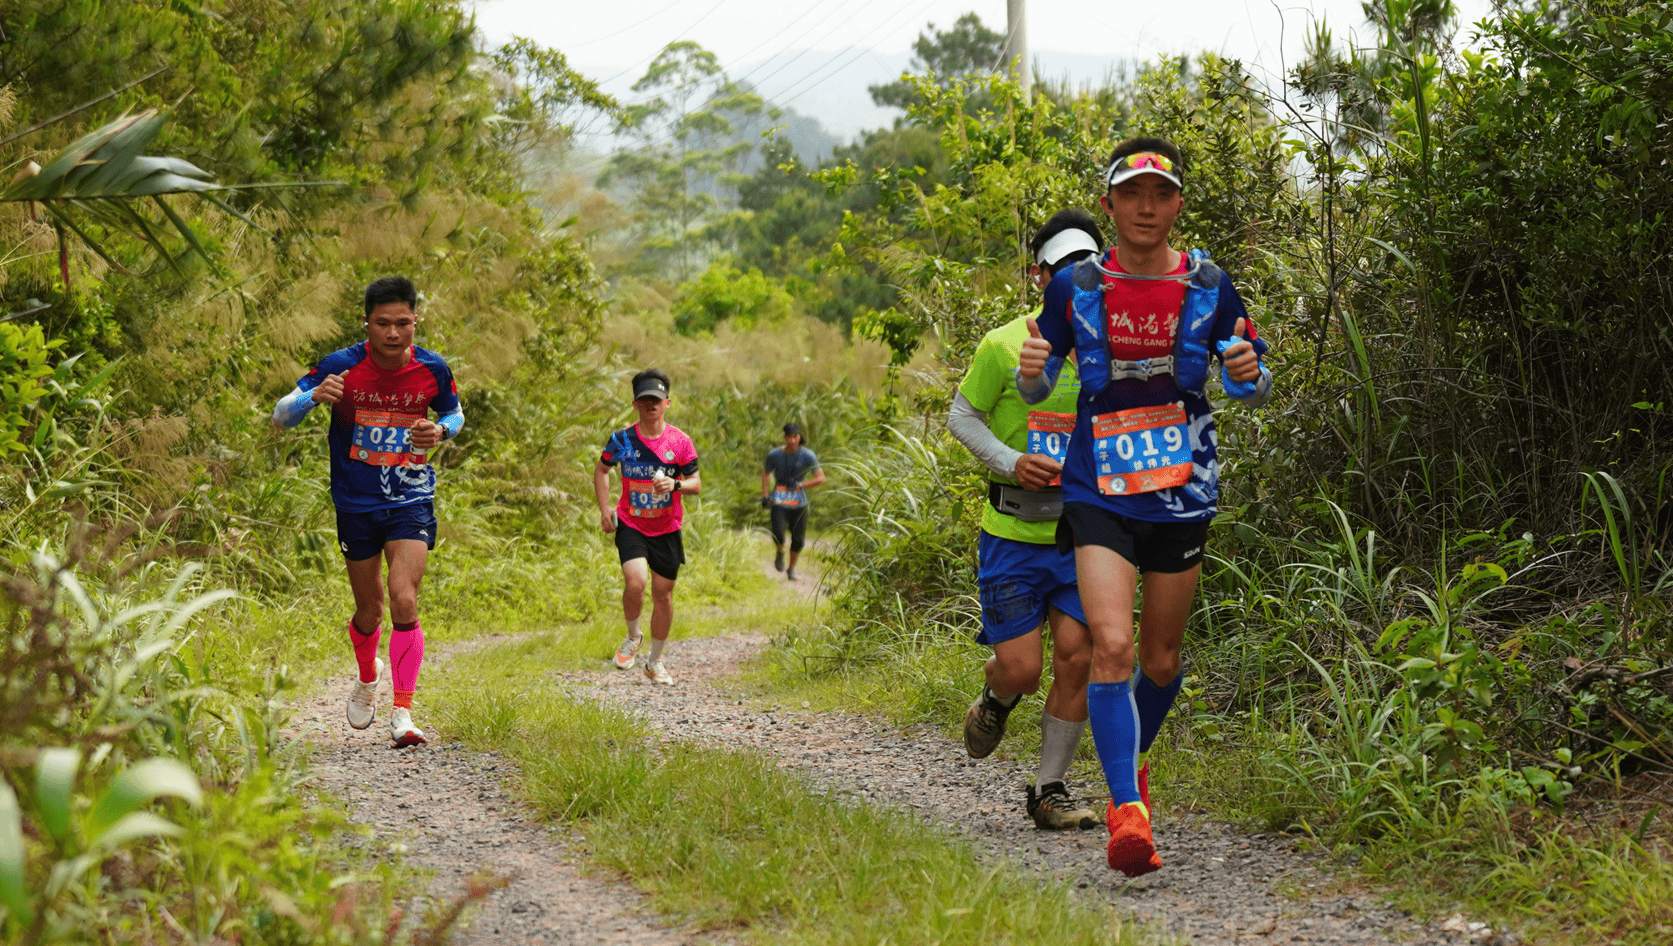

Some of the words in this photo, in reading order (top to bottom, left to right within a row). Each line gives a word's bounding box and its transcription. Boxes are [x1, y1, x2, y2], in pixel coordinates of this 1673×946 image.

[1112, 335, 1142, 346] CHENG
[1143, 338, 1168, 347] GANG
[370, 427, 412, 445] 028
[1116, 426, 1183, 460] 019
